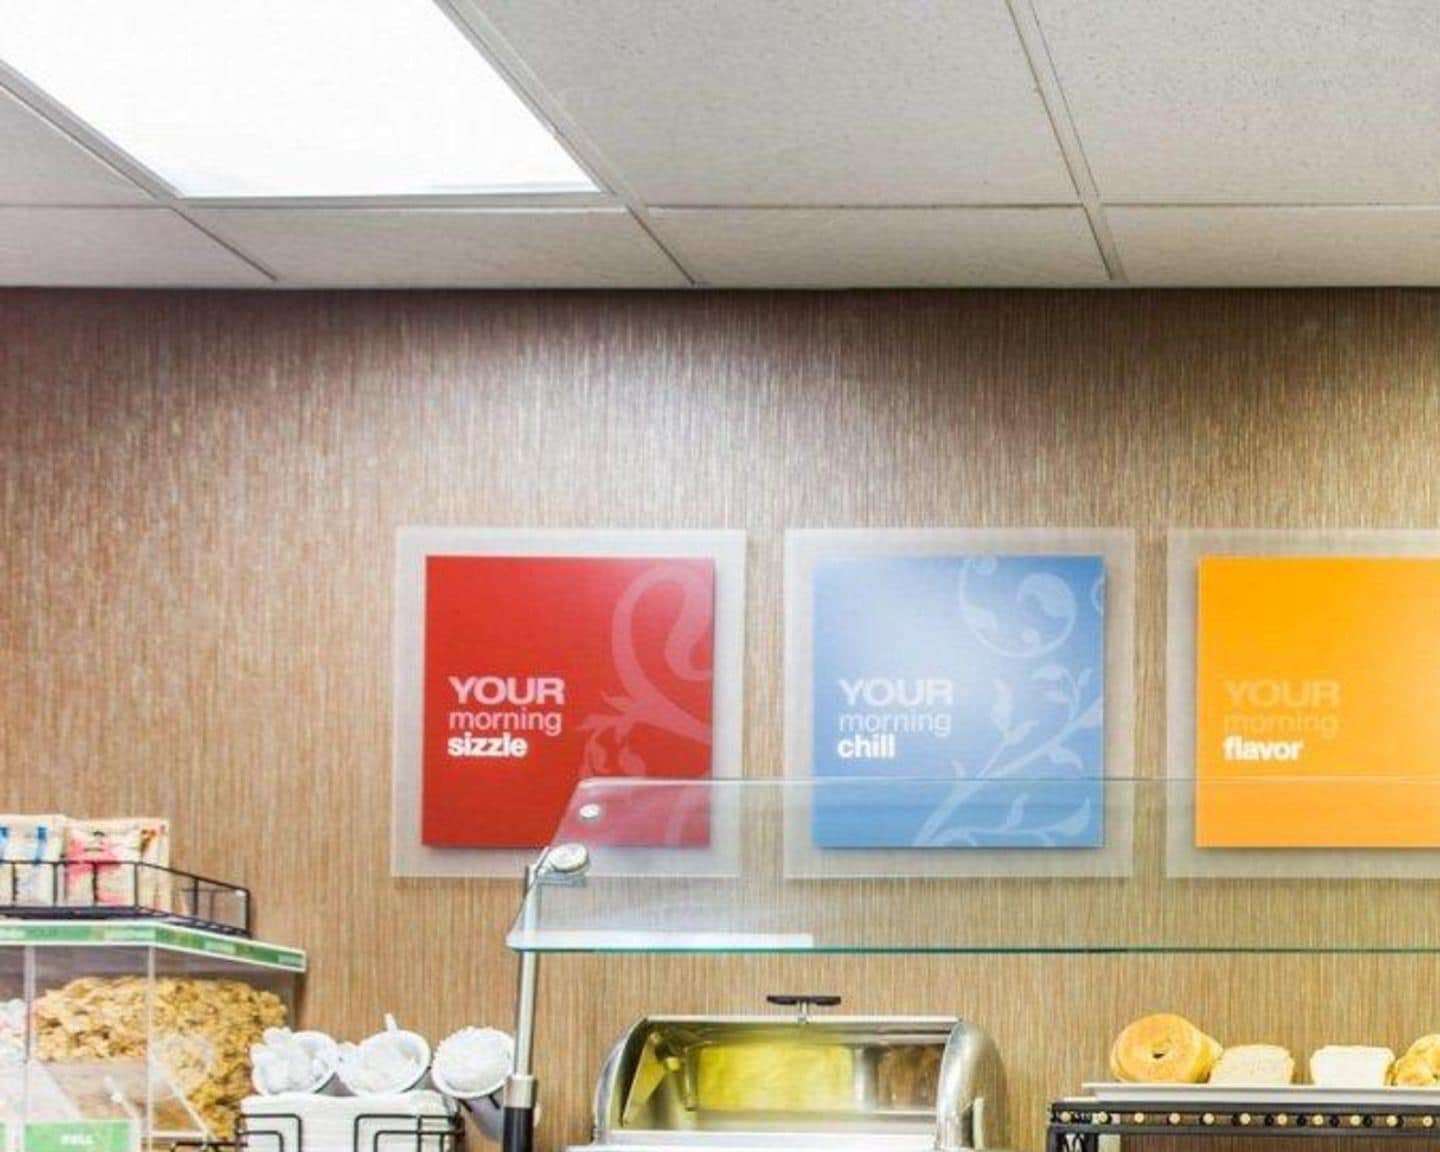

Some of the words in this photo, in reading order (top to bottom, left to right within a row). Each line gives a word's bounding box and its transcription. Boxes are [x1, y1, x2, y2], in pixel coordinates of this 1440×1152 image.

[447, 675, 566, 705] YOUR
[837, 678, 955, 706] YOUR
[1223, 679, 1341, 708] YOUR
[448, 706, 563, 737] morning
[838, 708, 952, 738] morning
[1223, 709, 1339, 741] morning
[447, 731, 529, 758] sizzle
[837, 733, 896, 759] chill
[1223, 735, 1304, 761] flavor
